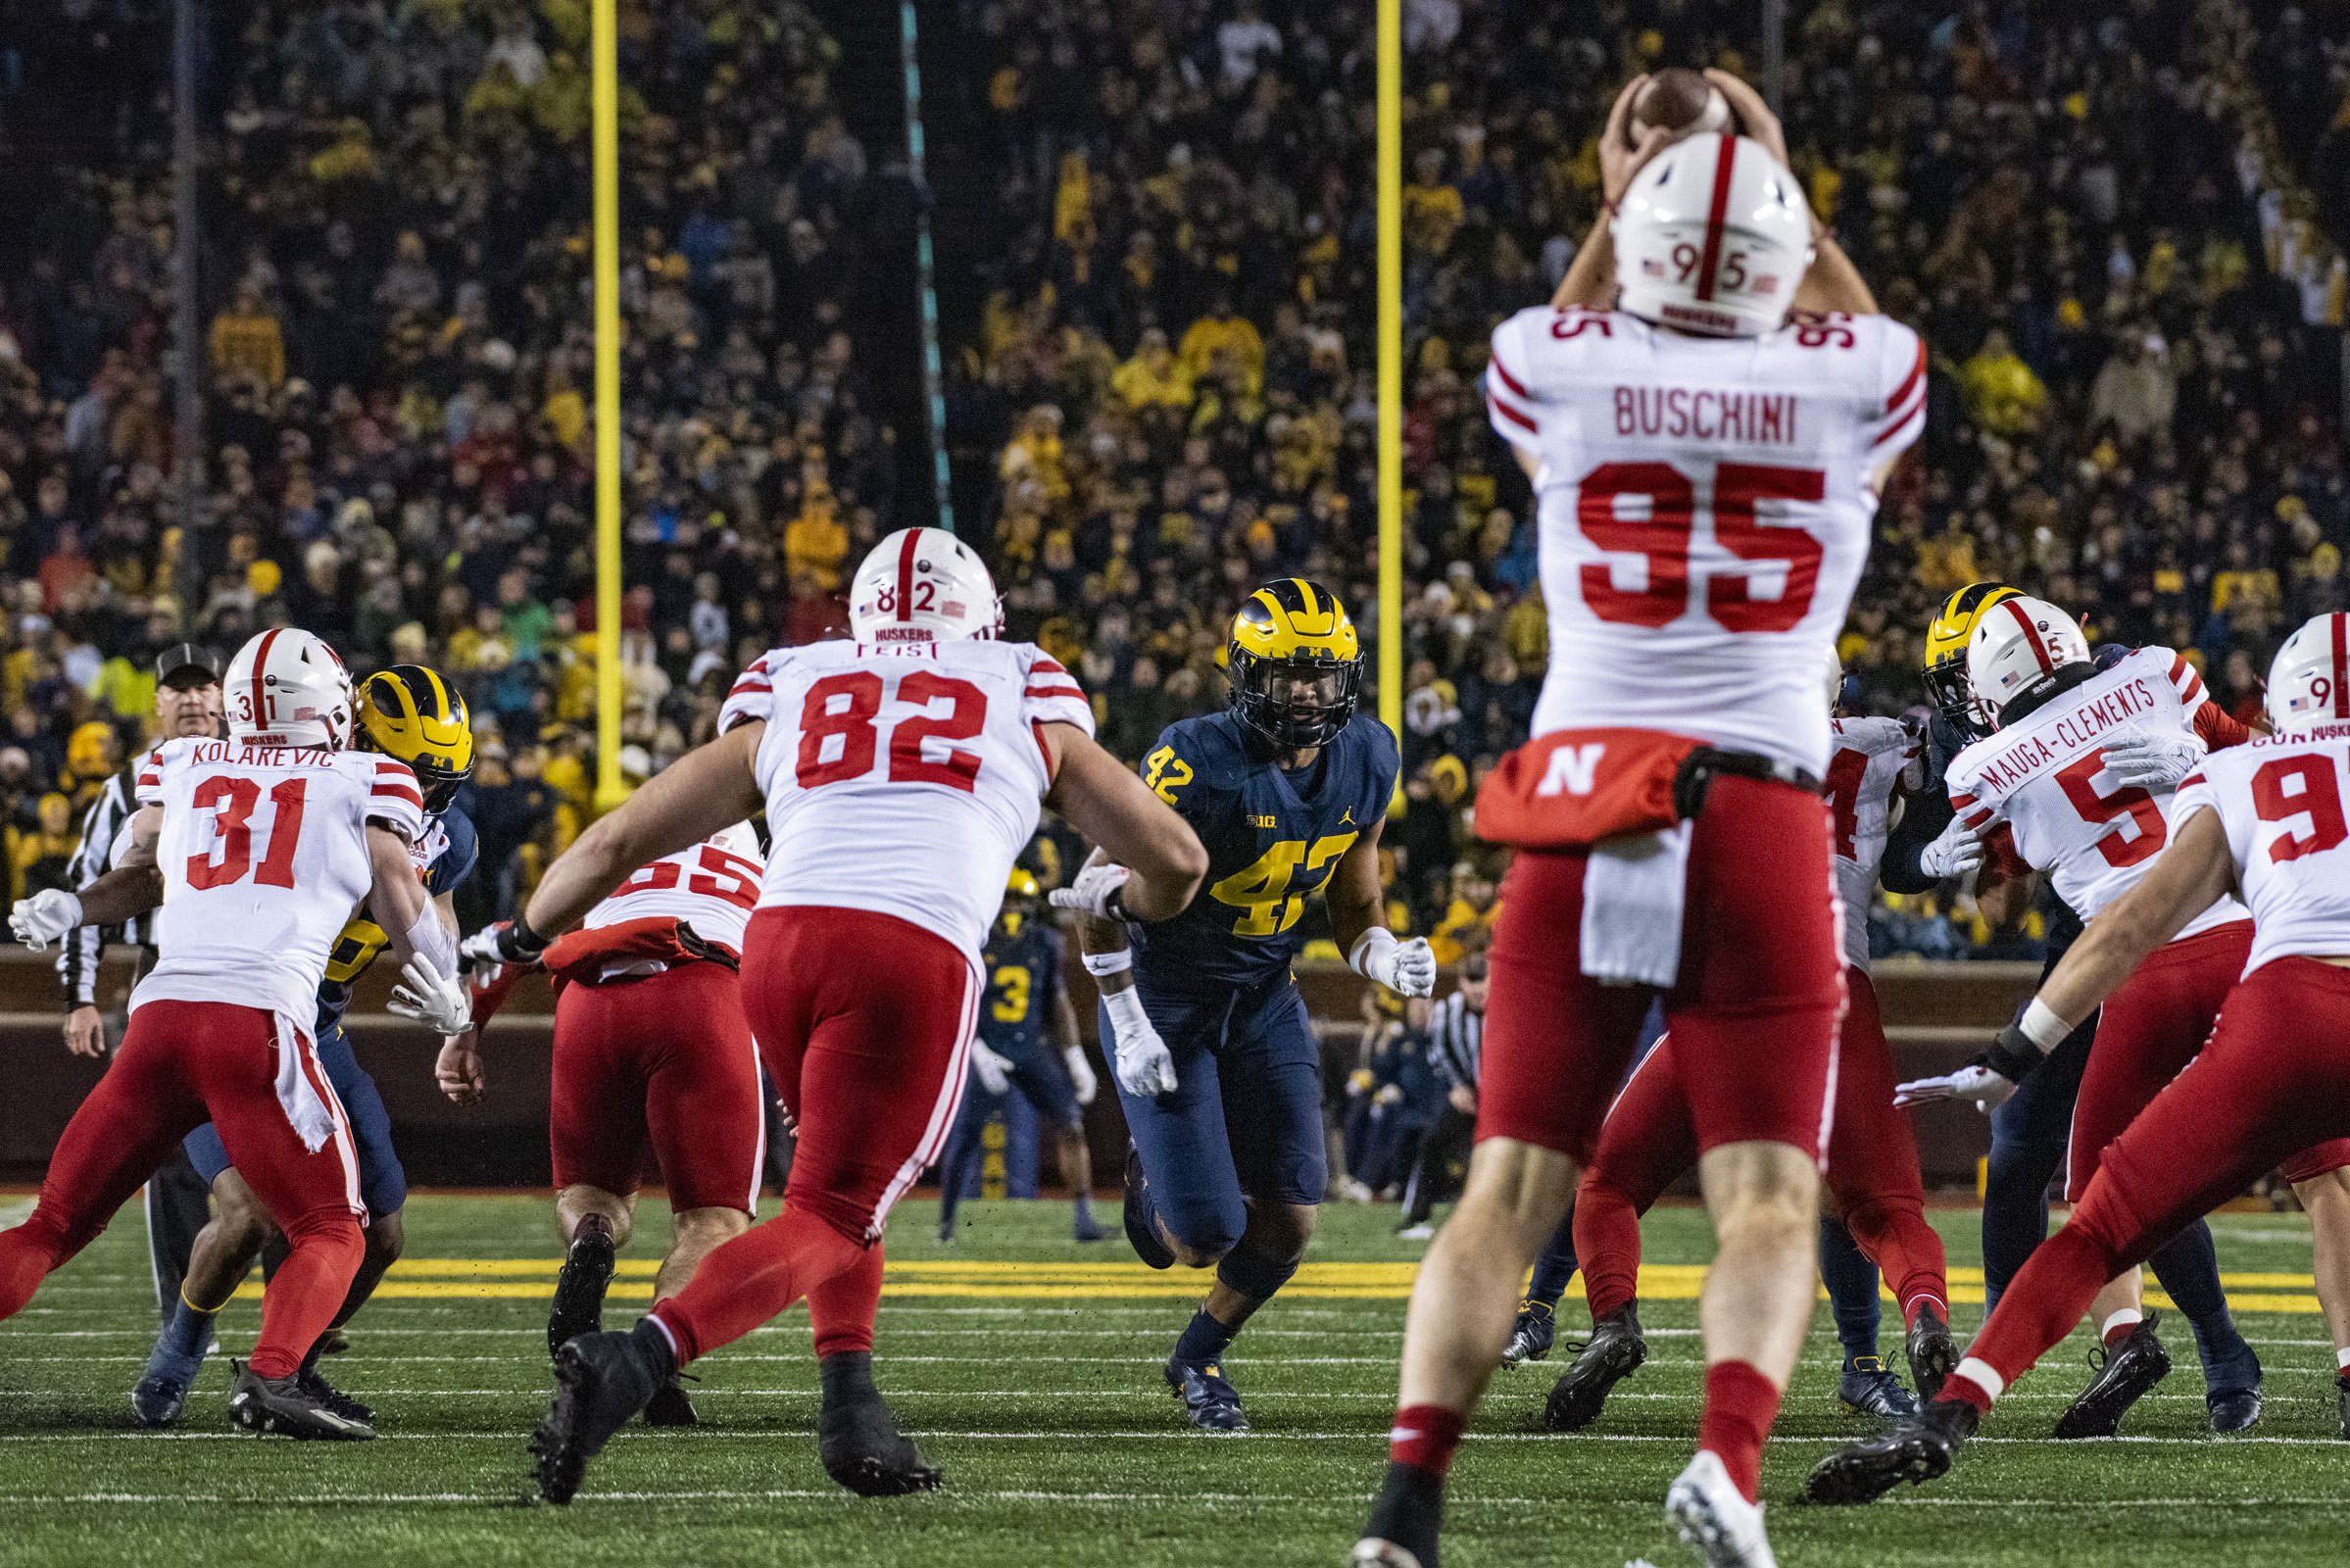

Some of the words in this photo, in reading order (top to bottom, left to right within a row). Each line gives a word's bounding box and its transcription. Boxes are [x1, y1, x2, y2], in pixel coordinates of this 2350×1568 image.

[1672, 242, 1747, 291] 95
[1613, 385, 1797, 444] BUSCHINI
[1576, 461, 1826, 633] 95
[876, 580, 936, 612] 82
[875, 628, 934, 642] HUSKERS
[1308, 647, 1323, 657] M
[237, 694, 277, 722] 31
[2310, 677, 2332, 708] 9
[191, 742, 337, 767] KOLAREVIC
[241, 734, 288, 746] HUSKERS
[795, 669, 988, 795] 82
[1979, 678, 2155, 795] MAUGA-CLEMENTS
[2311, 725, 2350, 739] HUSK
[431, 757, 446, 767] M
[1145, 745, 1195, 806] 42
[1537, 744, 1607, 797] N
[186, 775, 307, 891] 31
[2053, 746, 2168, 868] 5
[2250, 753, 2350, 864] 9
[1208, 830, 1360, 937] 42
[992, 965, 1030, 1023] 3
